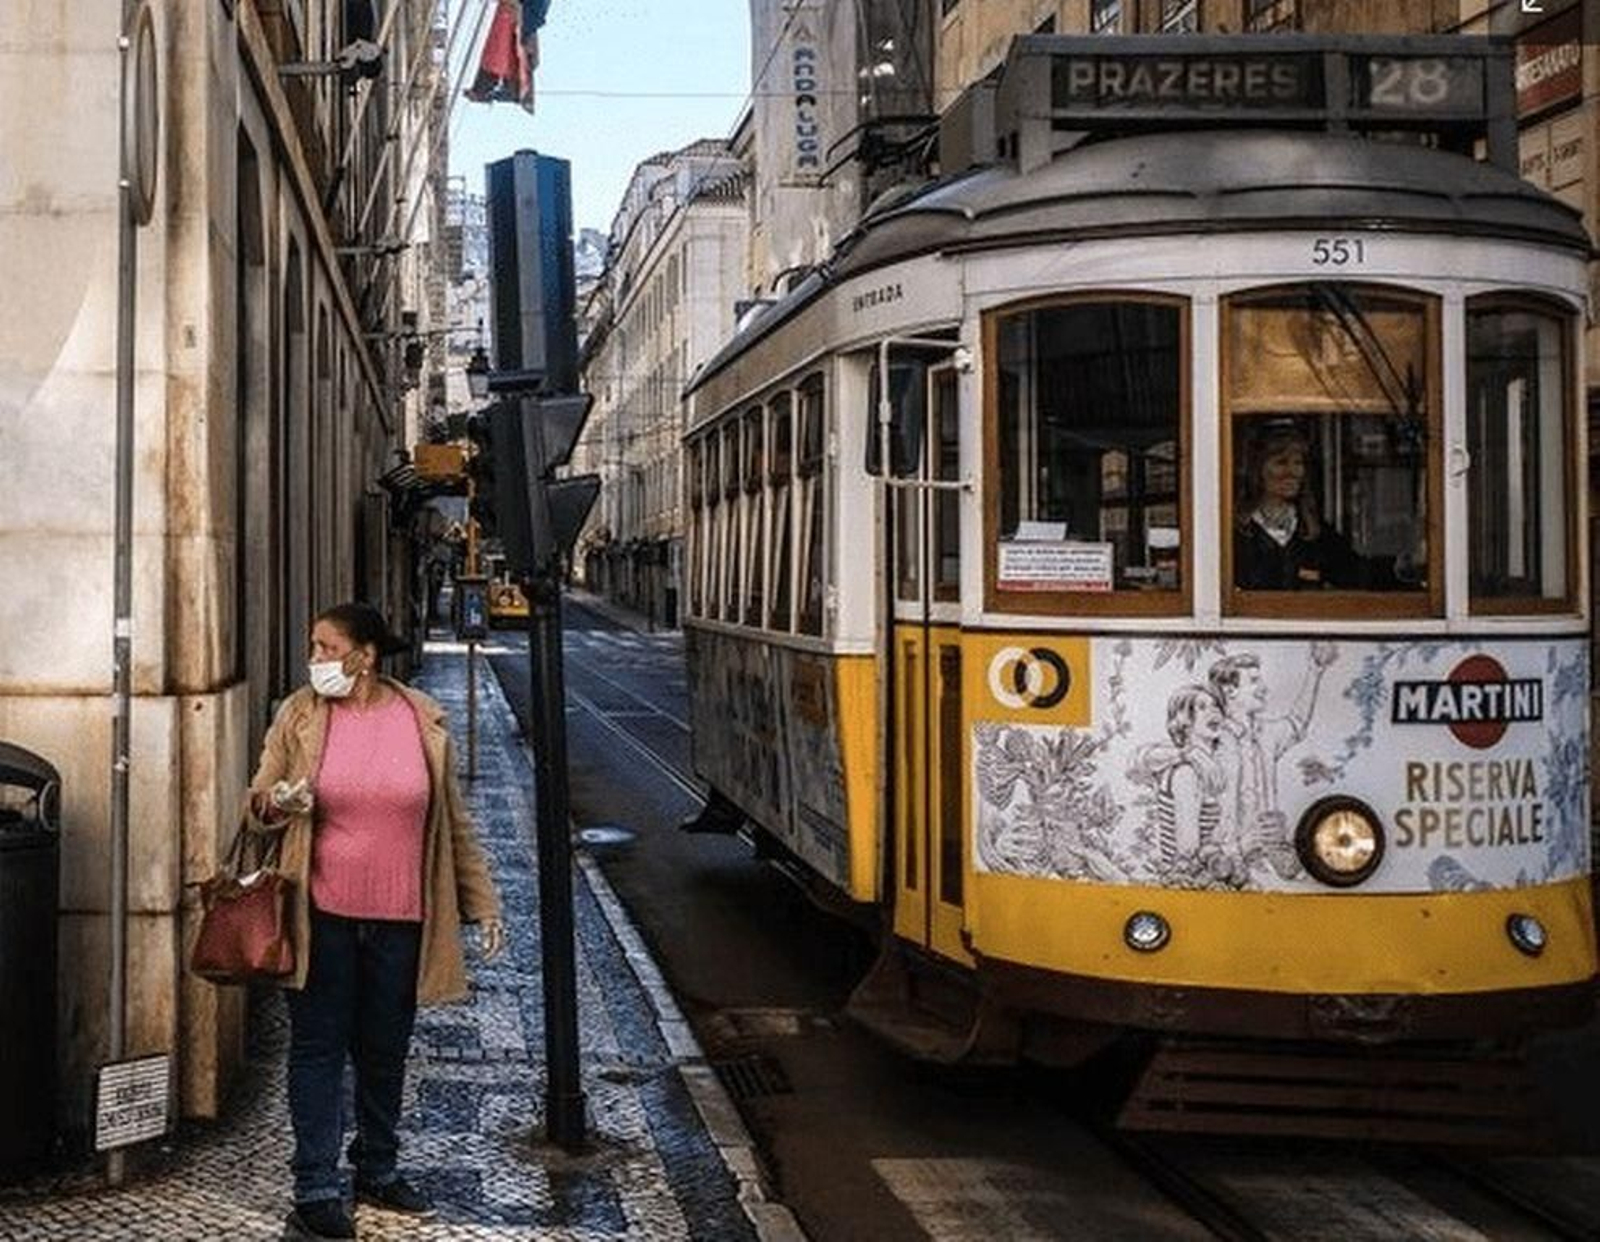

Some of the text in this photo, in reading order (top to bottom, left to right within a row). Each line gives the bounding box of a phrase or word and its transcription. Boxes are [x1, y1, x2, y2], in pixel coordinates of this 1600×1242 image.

[1069, 61, 1297, 98] PRAZERES
[1370, 59, 1449, 103] 28
[1313, 239, 1363, 265] 551
[1397, 683, 1539, 721] MARTINI
[1406, 758, 1537, 802] RISERVA
[1394, 803, 1544, 848] SPECIALE
